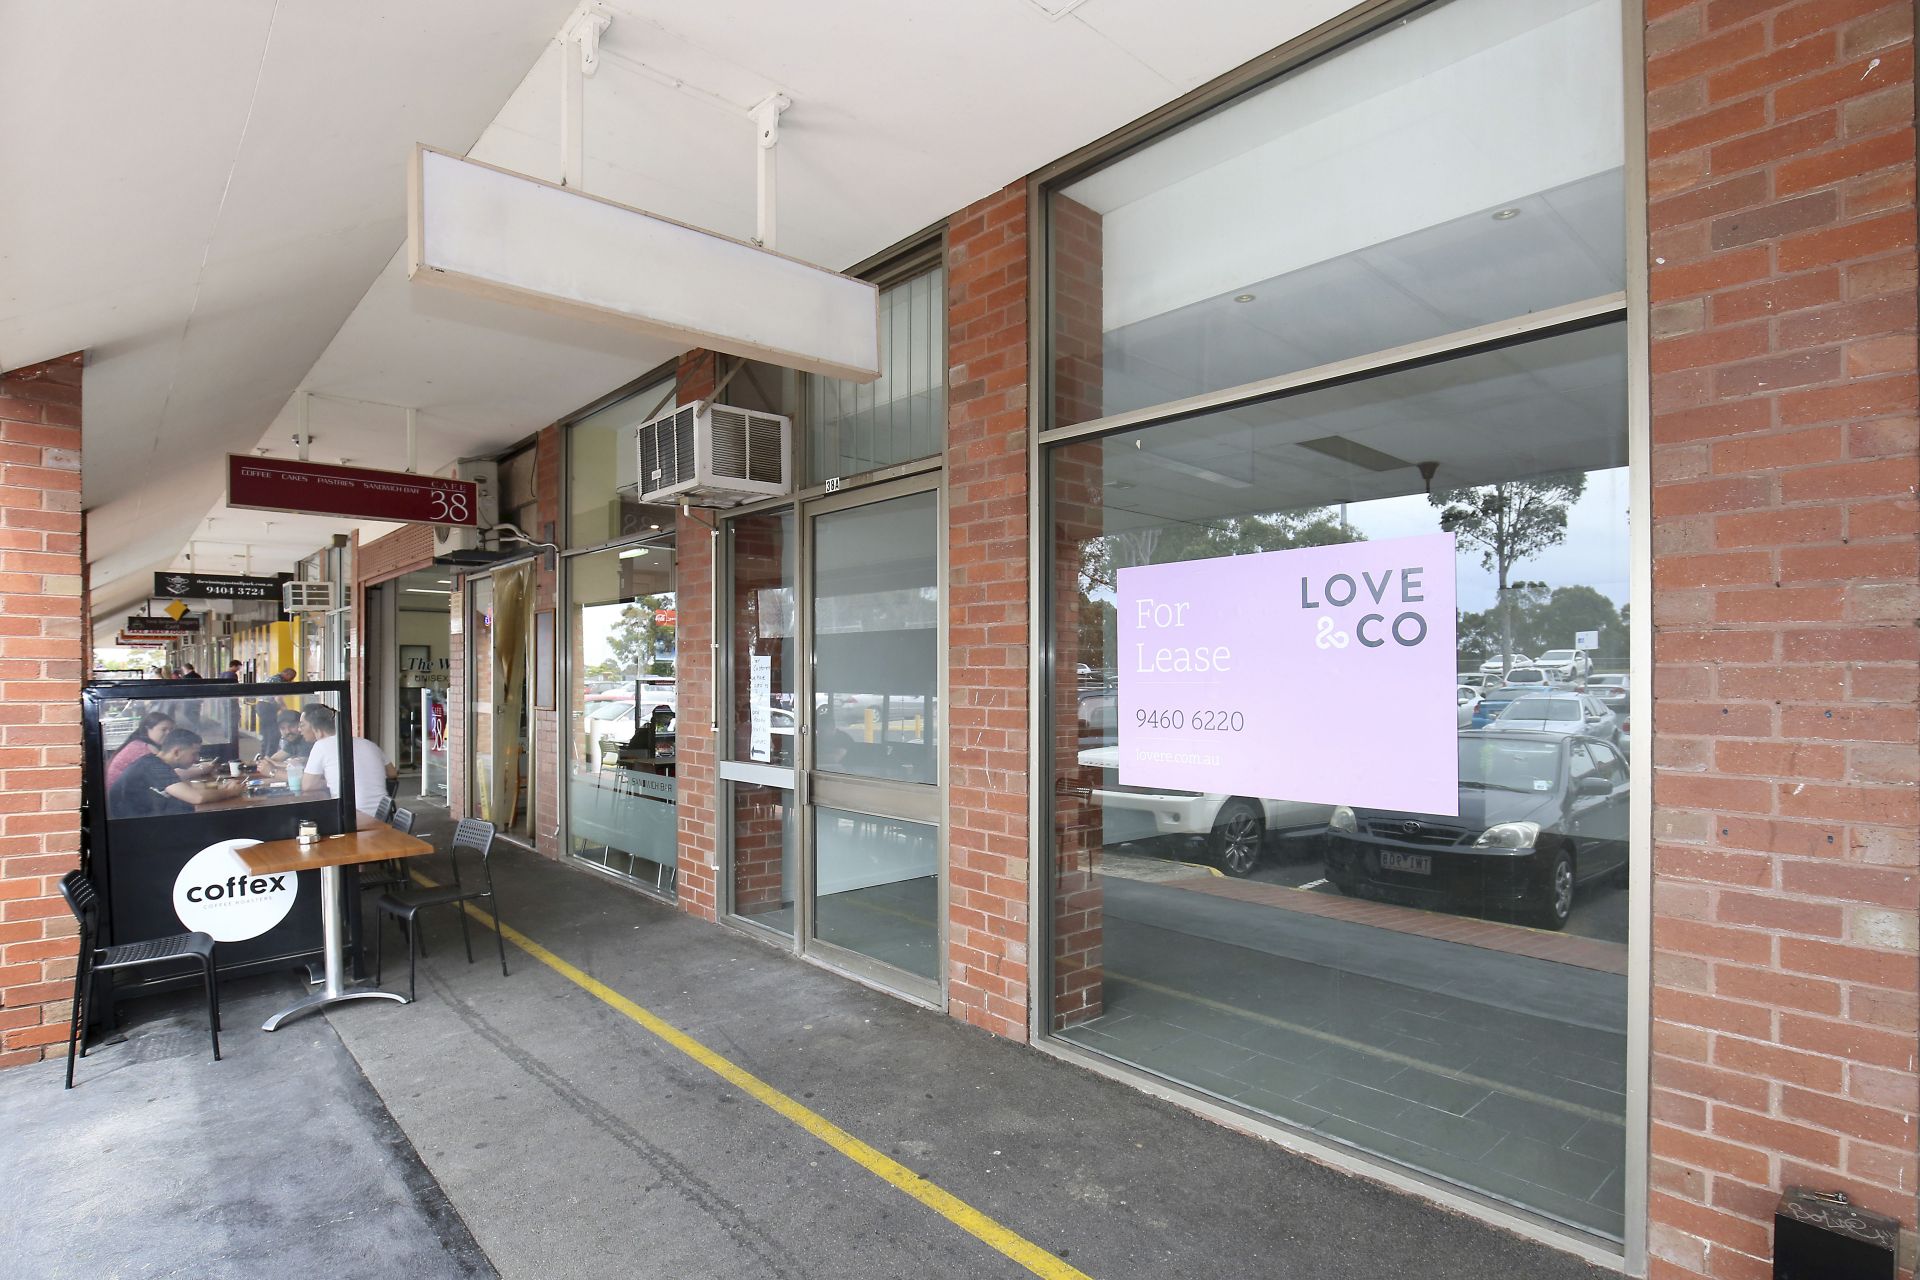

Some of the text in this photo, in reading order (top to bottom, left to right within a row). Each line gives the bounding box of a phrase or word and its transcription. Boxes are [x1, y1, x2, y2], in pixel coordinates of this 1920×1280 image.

[241, 469, 420, 494] COFFEE CAKES PASTRIES SANDWICH BAR
[431, 480, 467, 491] CAFE
[826, 479, 839, 492] 38A
[430, 490, 468, 522] 38
[206, 586, 265, 596] 9404 3724
[1302, 566, 1424, 609] LOVE
[1135, 598, 1190, 629] For
[1315, 611, 1428, 650] & CO
[408, 657, 434, 671] The
[1136, 642, 1231, 674] Lease
[1136, 708, 1245, 732] 9460 6220
[431, 717, 443, 752] 38
[1135, 748, 1221, 767] lovere.com.au
[186, 875, 286, 903] coffex
